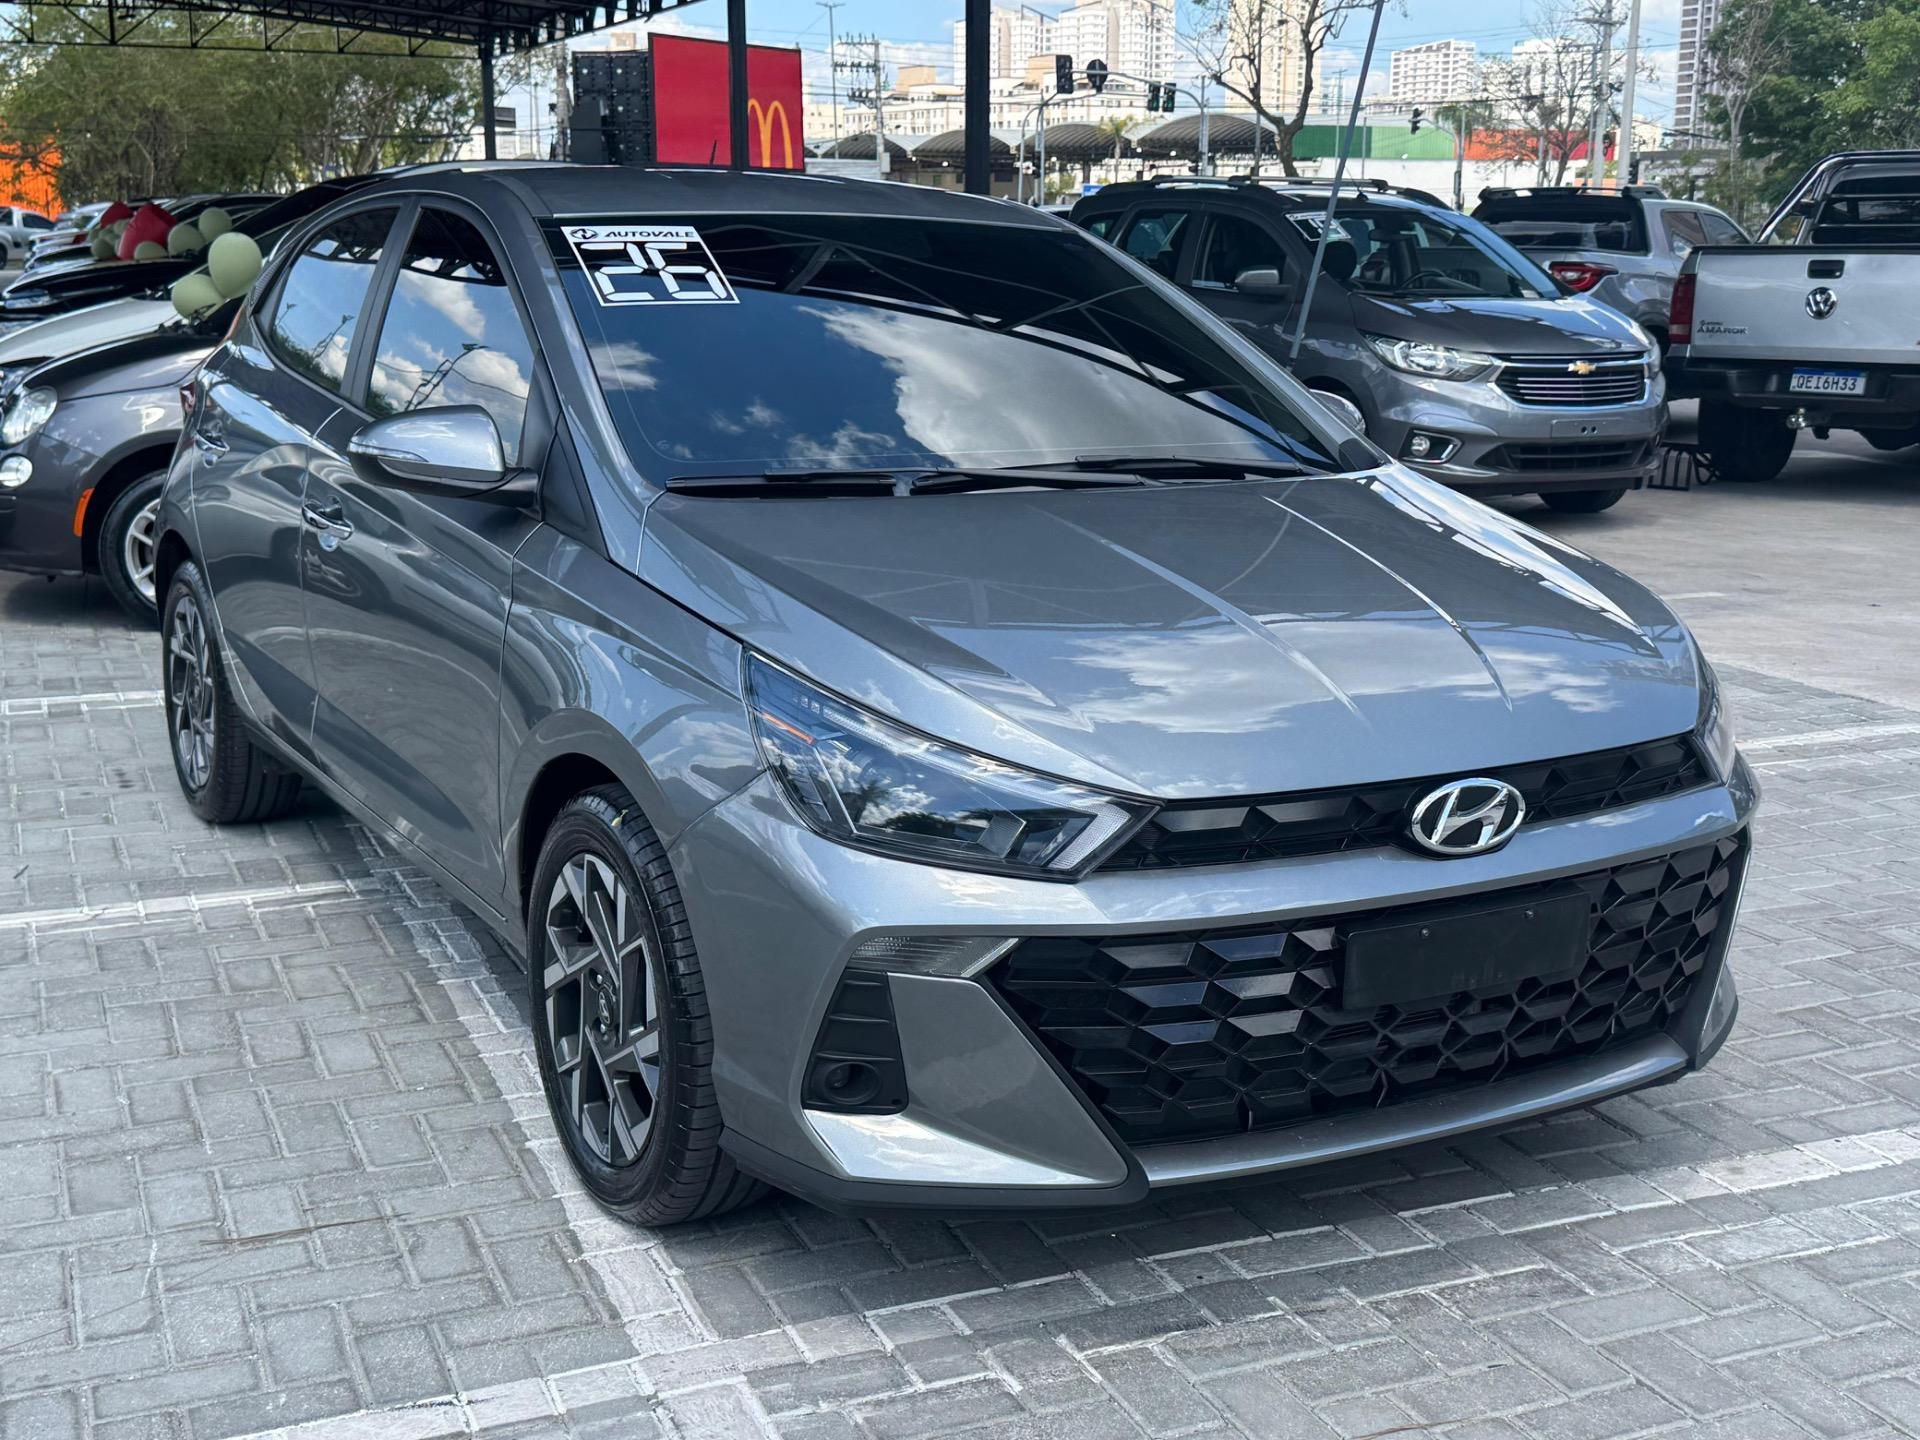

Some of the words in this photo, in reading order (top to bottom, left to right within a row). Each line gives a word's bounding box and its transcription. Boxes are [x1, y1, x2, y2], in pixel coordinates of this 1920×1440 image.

[604, 230, 695, 238] AUTOVALE
[580, 241, 728, 302] 26
[1696, 325, 1747, 334] AMAROK
[1796, 375, 1858, 391] QEI6H33
